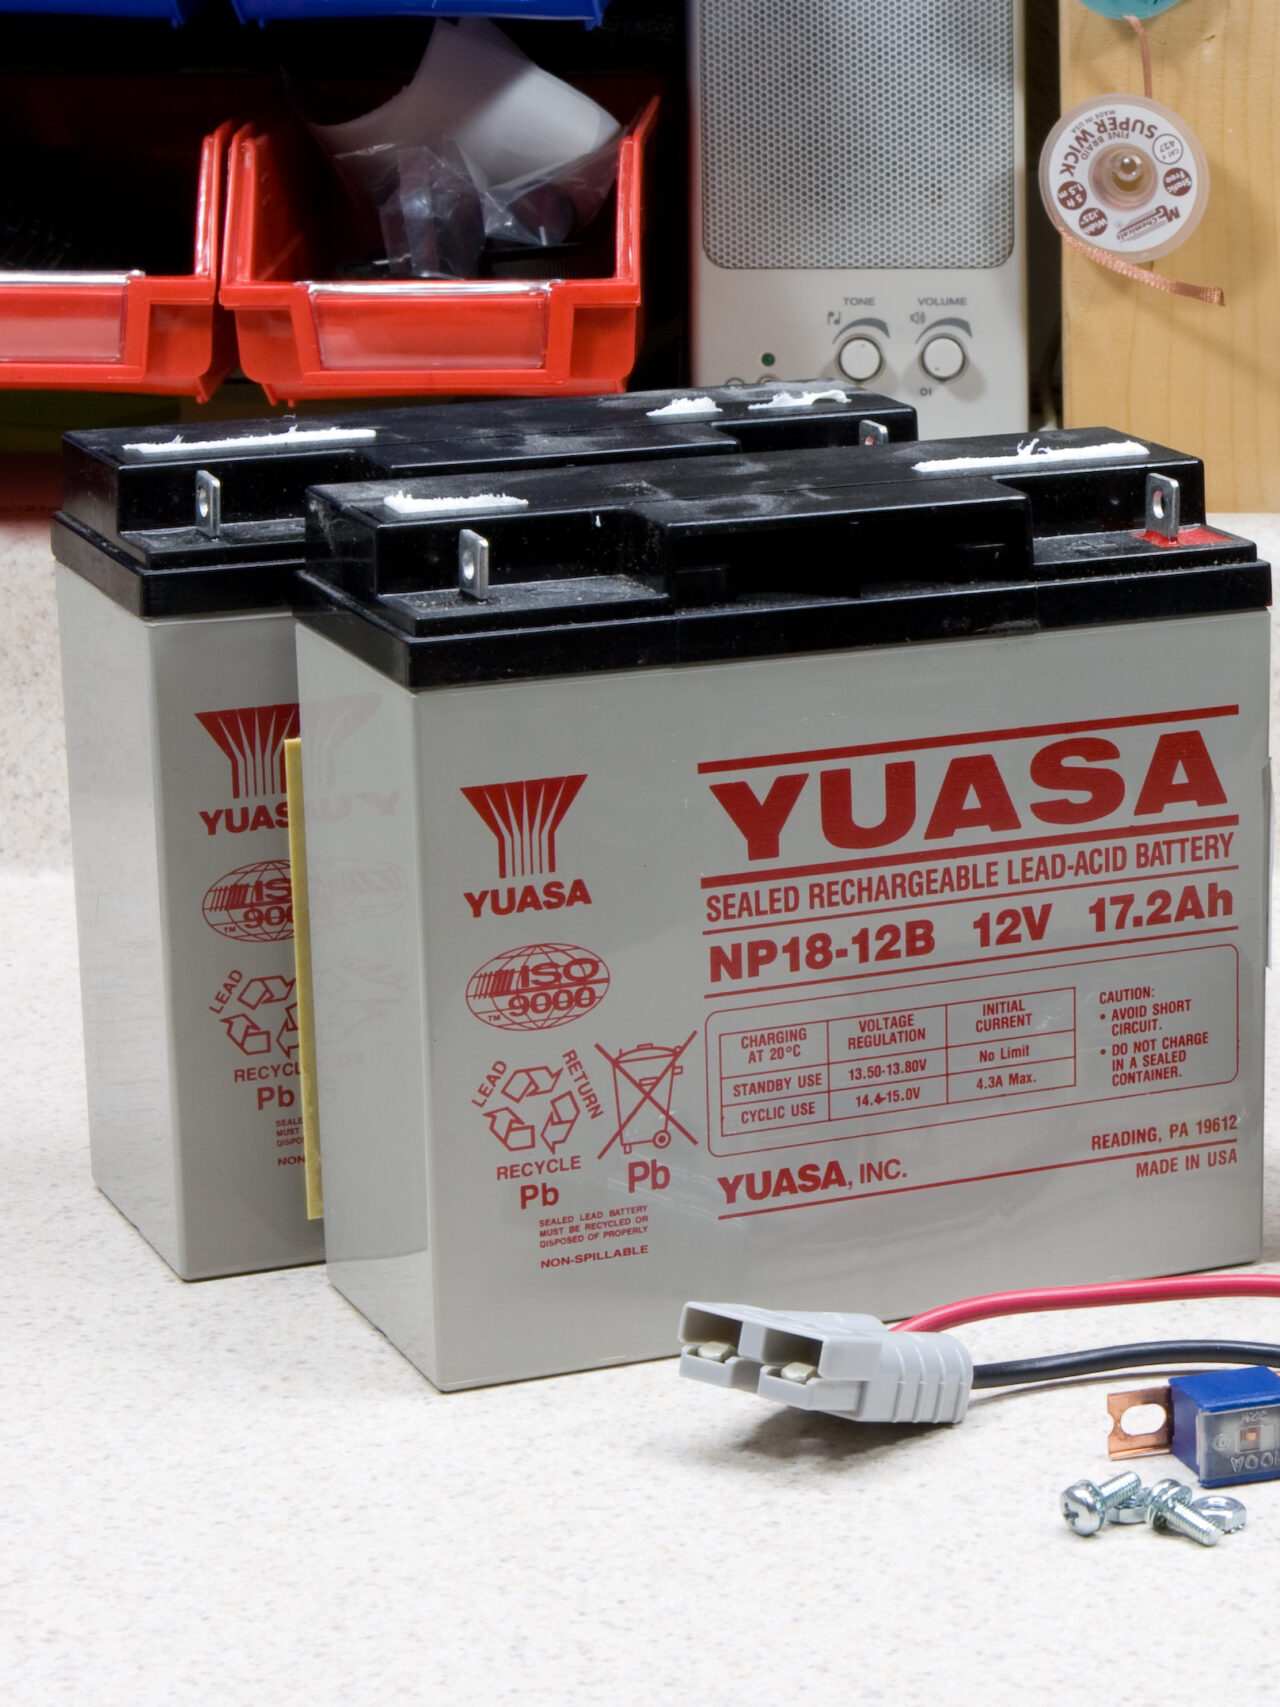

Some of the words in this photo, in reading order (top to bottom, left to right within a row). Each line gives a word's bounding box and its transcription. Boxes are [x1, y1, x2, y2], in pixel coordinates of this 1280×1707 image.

[1095, 116, 1158, 140] SUPER
[1108, 131, 1130, 141] FINE
[1059, 128, 1095, 177] WICK
[1081, 133, 1105, 160] BRAID
[1166, 177, 1192, 193] Static
[842, 297, 876, 307] TONE
[917, 297, 968, 306] VOLUME
[709, 730, 1229, 861] YUASA
[706, 885, 800, 922] SEALED
[809, 861, 998, 910] RECHARGEABLE
[1007, 846, 1128, 887] LEAD-ACID
[1136, 832, 1235, 870] BATTERY
[463, 879, 593, 918] YUASA
[709, 920, 936, 983] NP18-12B
[973, 904, 1053, 947] 12V
[1088, 882, 1234, 933] 17.2Ah
[519, 957, 600, 988] ISO
[209, 970, 243, 1014] LEAD
[508, 986, 597, 1017] 9000
[1099, 986, 1155, 1004] CAUTION:
[982, 999, 1026, 1016] INITIAL
[1111, 1006, 1147, 1022] AVOID
[1152, 999, 1192, 1016] SHORT
[858, 1014, 915, 1034] VOLTAGE
[975, 1013, 1033, 1033] CURRENT
[1111, 1018, 1162, 1036] CIRCUIT.
[740, 1028, 808, 1050] CHARGING
[848, 1028, 926, 1051] REGULATION
[1112, 1043, 1128, 1056] DO
[1133, 1039, 1157, 1053] NOT
[1162, 1032, 1209, 1050] CHARGE
[748, 1051, 765, 1064] AT
[769, 1044, 801, 1061] 20°C
[979, 1049, 995, 1063] No
[1001, 1045, 1030, 1061] Limit
[1112, 1059, 1125, 1072] IN
[1130, 1056, 1138, 1069] A
[1142, 1050, 1187, 1067] SEALED
[848, 1058, 927, 1081] 13.50-13.80V
[976, 1074, 1003, 1090] 4.3A
[1008, 1071, 1037, 1086] Max.
[1112, 1066, 1182, 1087] CONTAINER.
[471, 1060, 507, 1108] LEAD
[562, 1049, 604, 1119] RETURN
[733, 1076, 792, 1098] STANDBY
[797, 1073, 823, 1088] USE
[257, 1085, 295, 1110] Pb
[741, 1105, 785, 1125] CYCLIC
[791, 1102, 816, 1117] USE
[276, 1127, 300, 1137] MUST
[1092, 1126, 1162, 1151] READING,
[1169, 1121, 1189, 1138] PA
[1196, 1114, 1237, 1135] 19612
[496, 1155, 582, 1181] RECYCLE
[1136, 1157, 1178, 1178] MADE
[1185, 1154, 1200, 1171] IN
[1207, 1149, 1237, 1168] USA
[628, 1159, 671, 1193] Pb
[717, 1160, 853, 1204] YUASA,
[859, 1158, 907, 1184] INC.
[520, 1183, 559, 1210] Pb
[539, 1215, 574, 1227] SEALED
[579, 1211, 603, 1222] LEAD
[609, 1205, 648, 1217] BATTERY
[539, 1226, 563, 1237] MUST
[569, 1224, 580, 1233] BE
[585, 1218, 631, 1231] RECYCLED
[635, 1215, 648, 1223] OR
[540, 1236, 584, 1248] DISPOSED
[588, 1233, 599, 1241] OF
[603, 1226, 648, 1239] PROPERLY
[540, 1245, 649, 1269] NON-SPILLABLE
